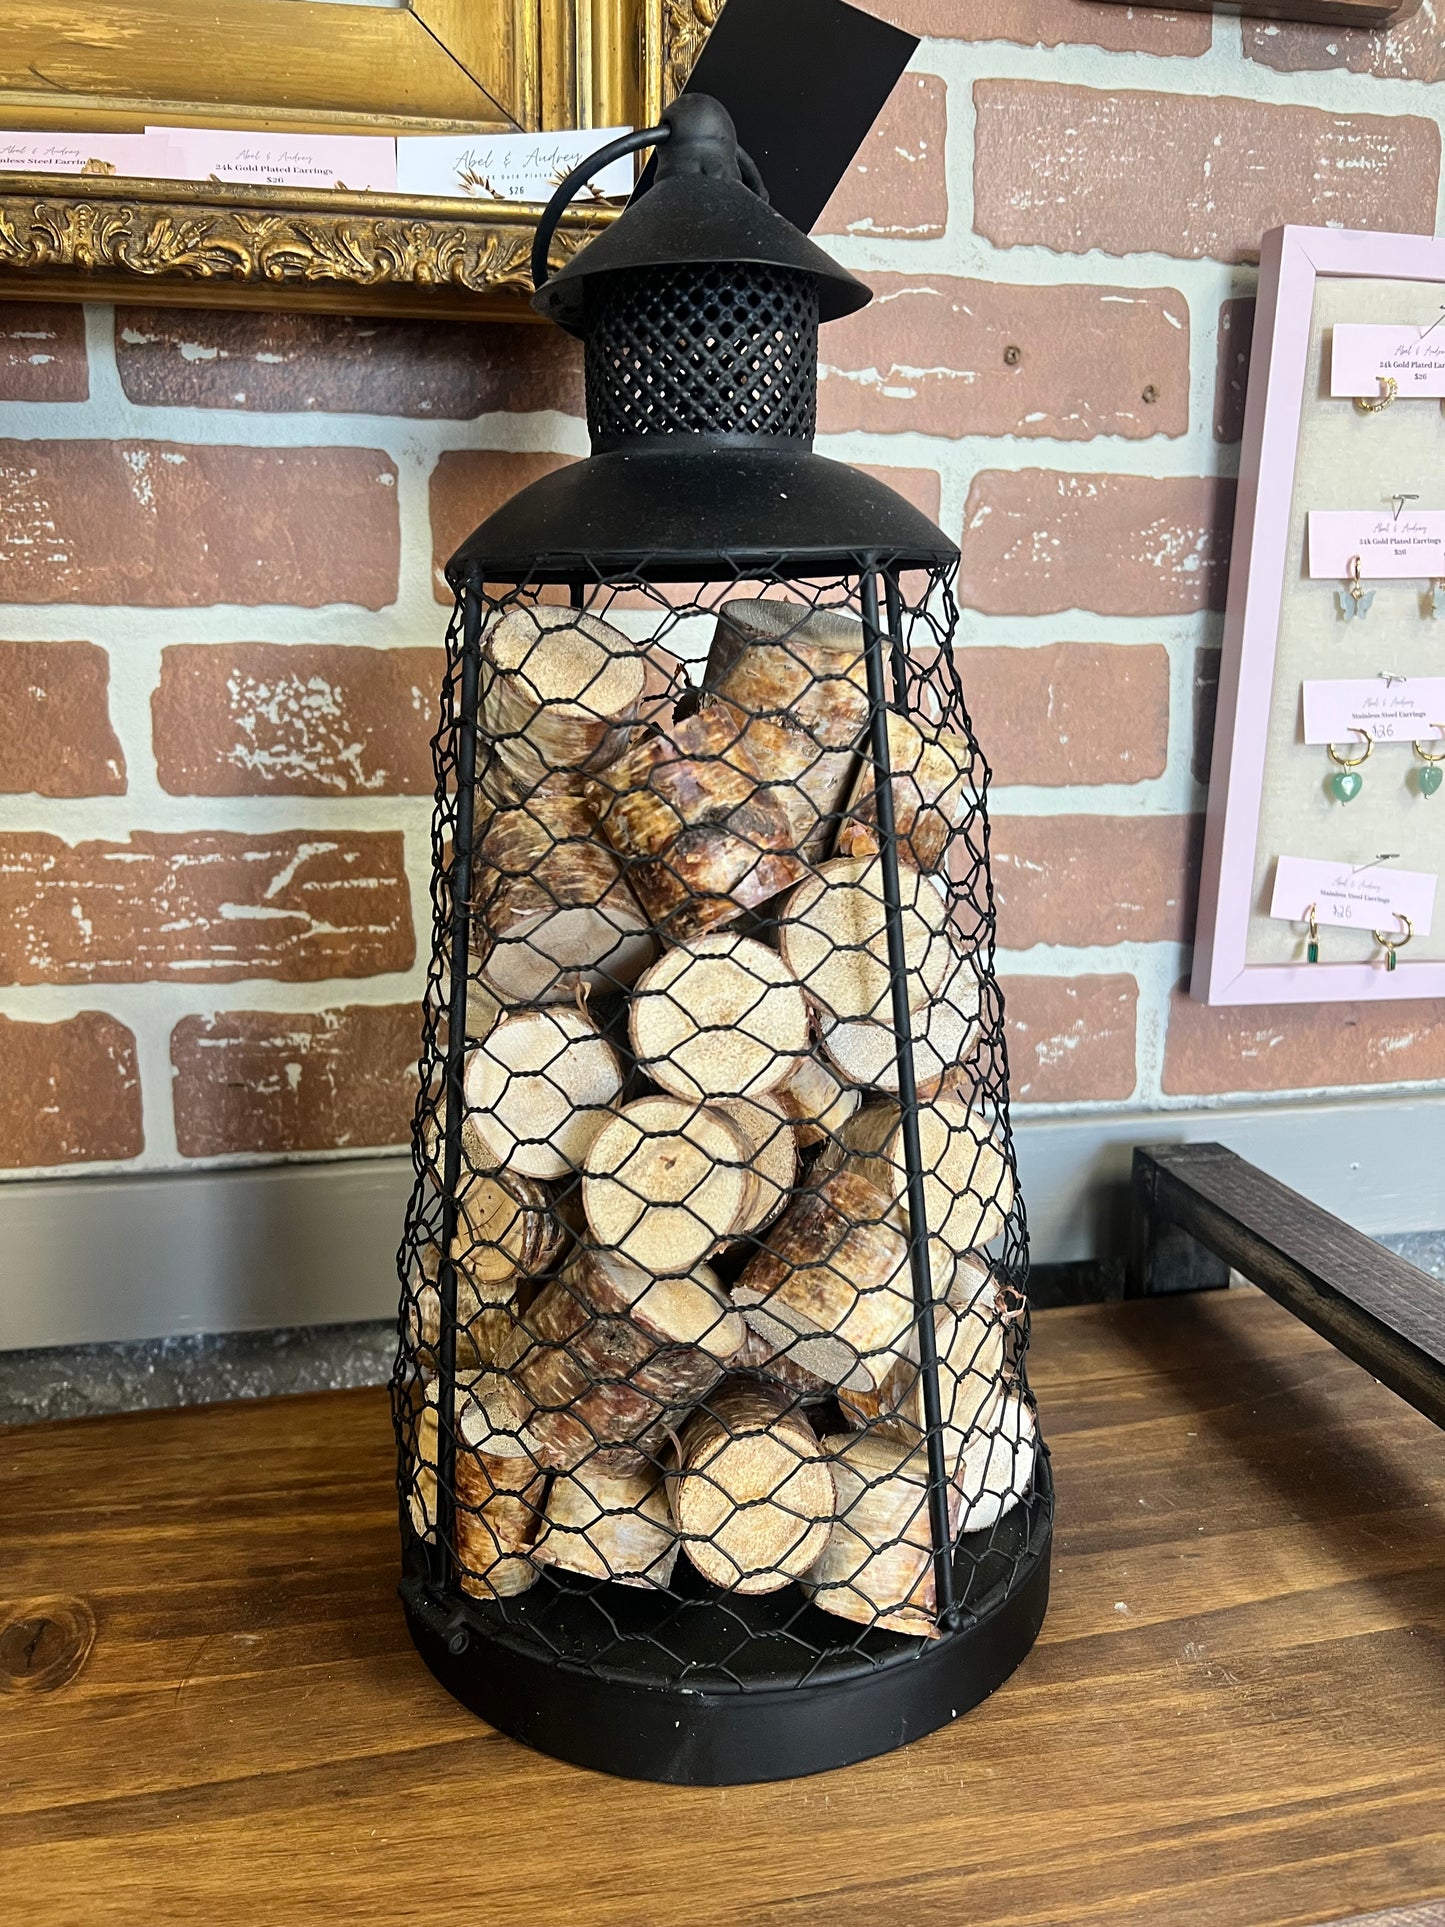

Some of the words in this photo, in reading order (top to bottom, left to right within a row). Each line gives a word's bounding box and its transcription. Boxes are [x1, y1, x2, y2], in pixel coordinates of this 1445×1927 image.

[452, 150, 493, 170] Abel
[504, 150, 511, 168] &
[523, 146, 583, 168] Audrey
[235, 164, 258, 172] Gold
[261, 165, 291, 173] Plated
[293, 167, 333, 175] Earrings
[266, 176, 284, 184] $26
[509, 186, 525, 195] $26
[1372, 537, 1388, 545] Gold
[1390, 537, 1411, 545] Plated
[1413, 537, 1441, 545] Earrings
